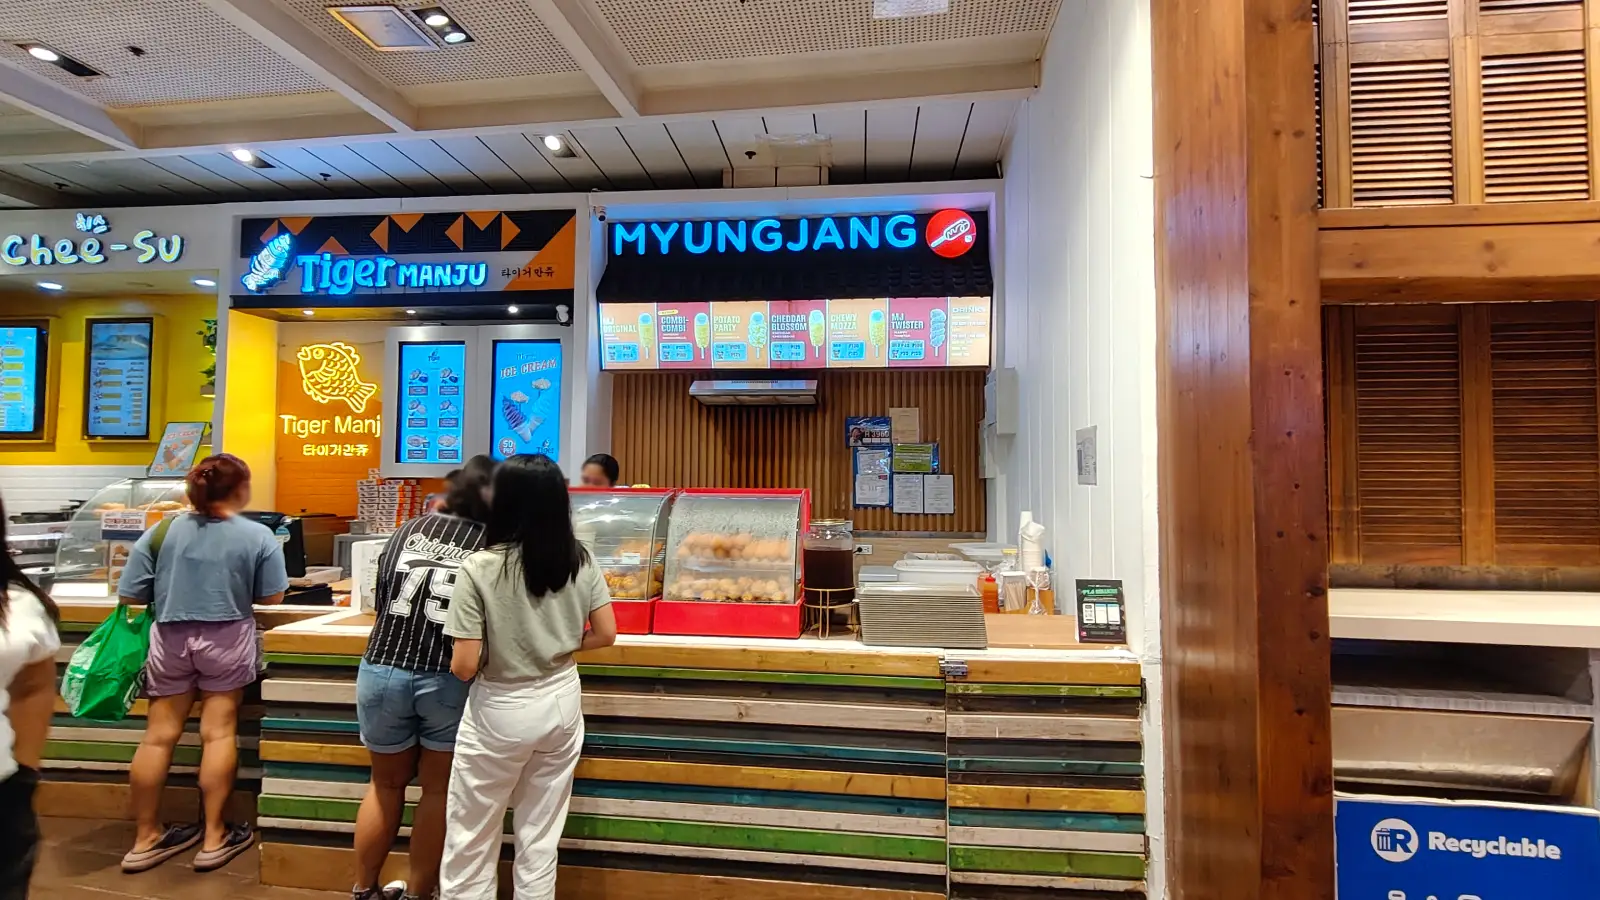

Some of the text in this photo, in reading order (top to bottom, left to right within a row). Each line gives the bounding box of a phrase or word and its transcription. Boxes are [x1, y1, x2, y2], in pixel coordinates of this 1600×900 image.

[614, 214, 917, 255] MYUNGJANG
[297, 252, 487, 295] Tiger MANJU
[661, 316, 689, 324] COMBI-
[713, 315, 740, 324] POTATO
[771, 314, 806, 323] CHEDDAR
[830, 313, 857, 322] CHEWY
[891, 313, 904, 321] MJ
[603, 324, 637, 333] ORIGINAL
[661, 324, 686, 333] COMBI
[713, 323, 737, 332] PARTY
[771, 322, 807, 331] BLOSSOM
[830, 321, 857, 330] MOZZA
[891, 320, 924, 330] TWISTER
[500, 358, 557, 379] ICE CREAM
[279, 414, 381, 438] Tiger Manj
[1428, 831, 1562, 860] Recyclable
